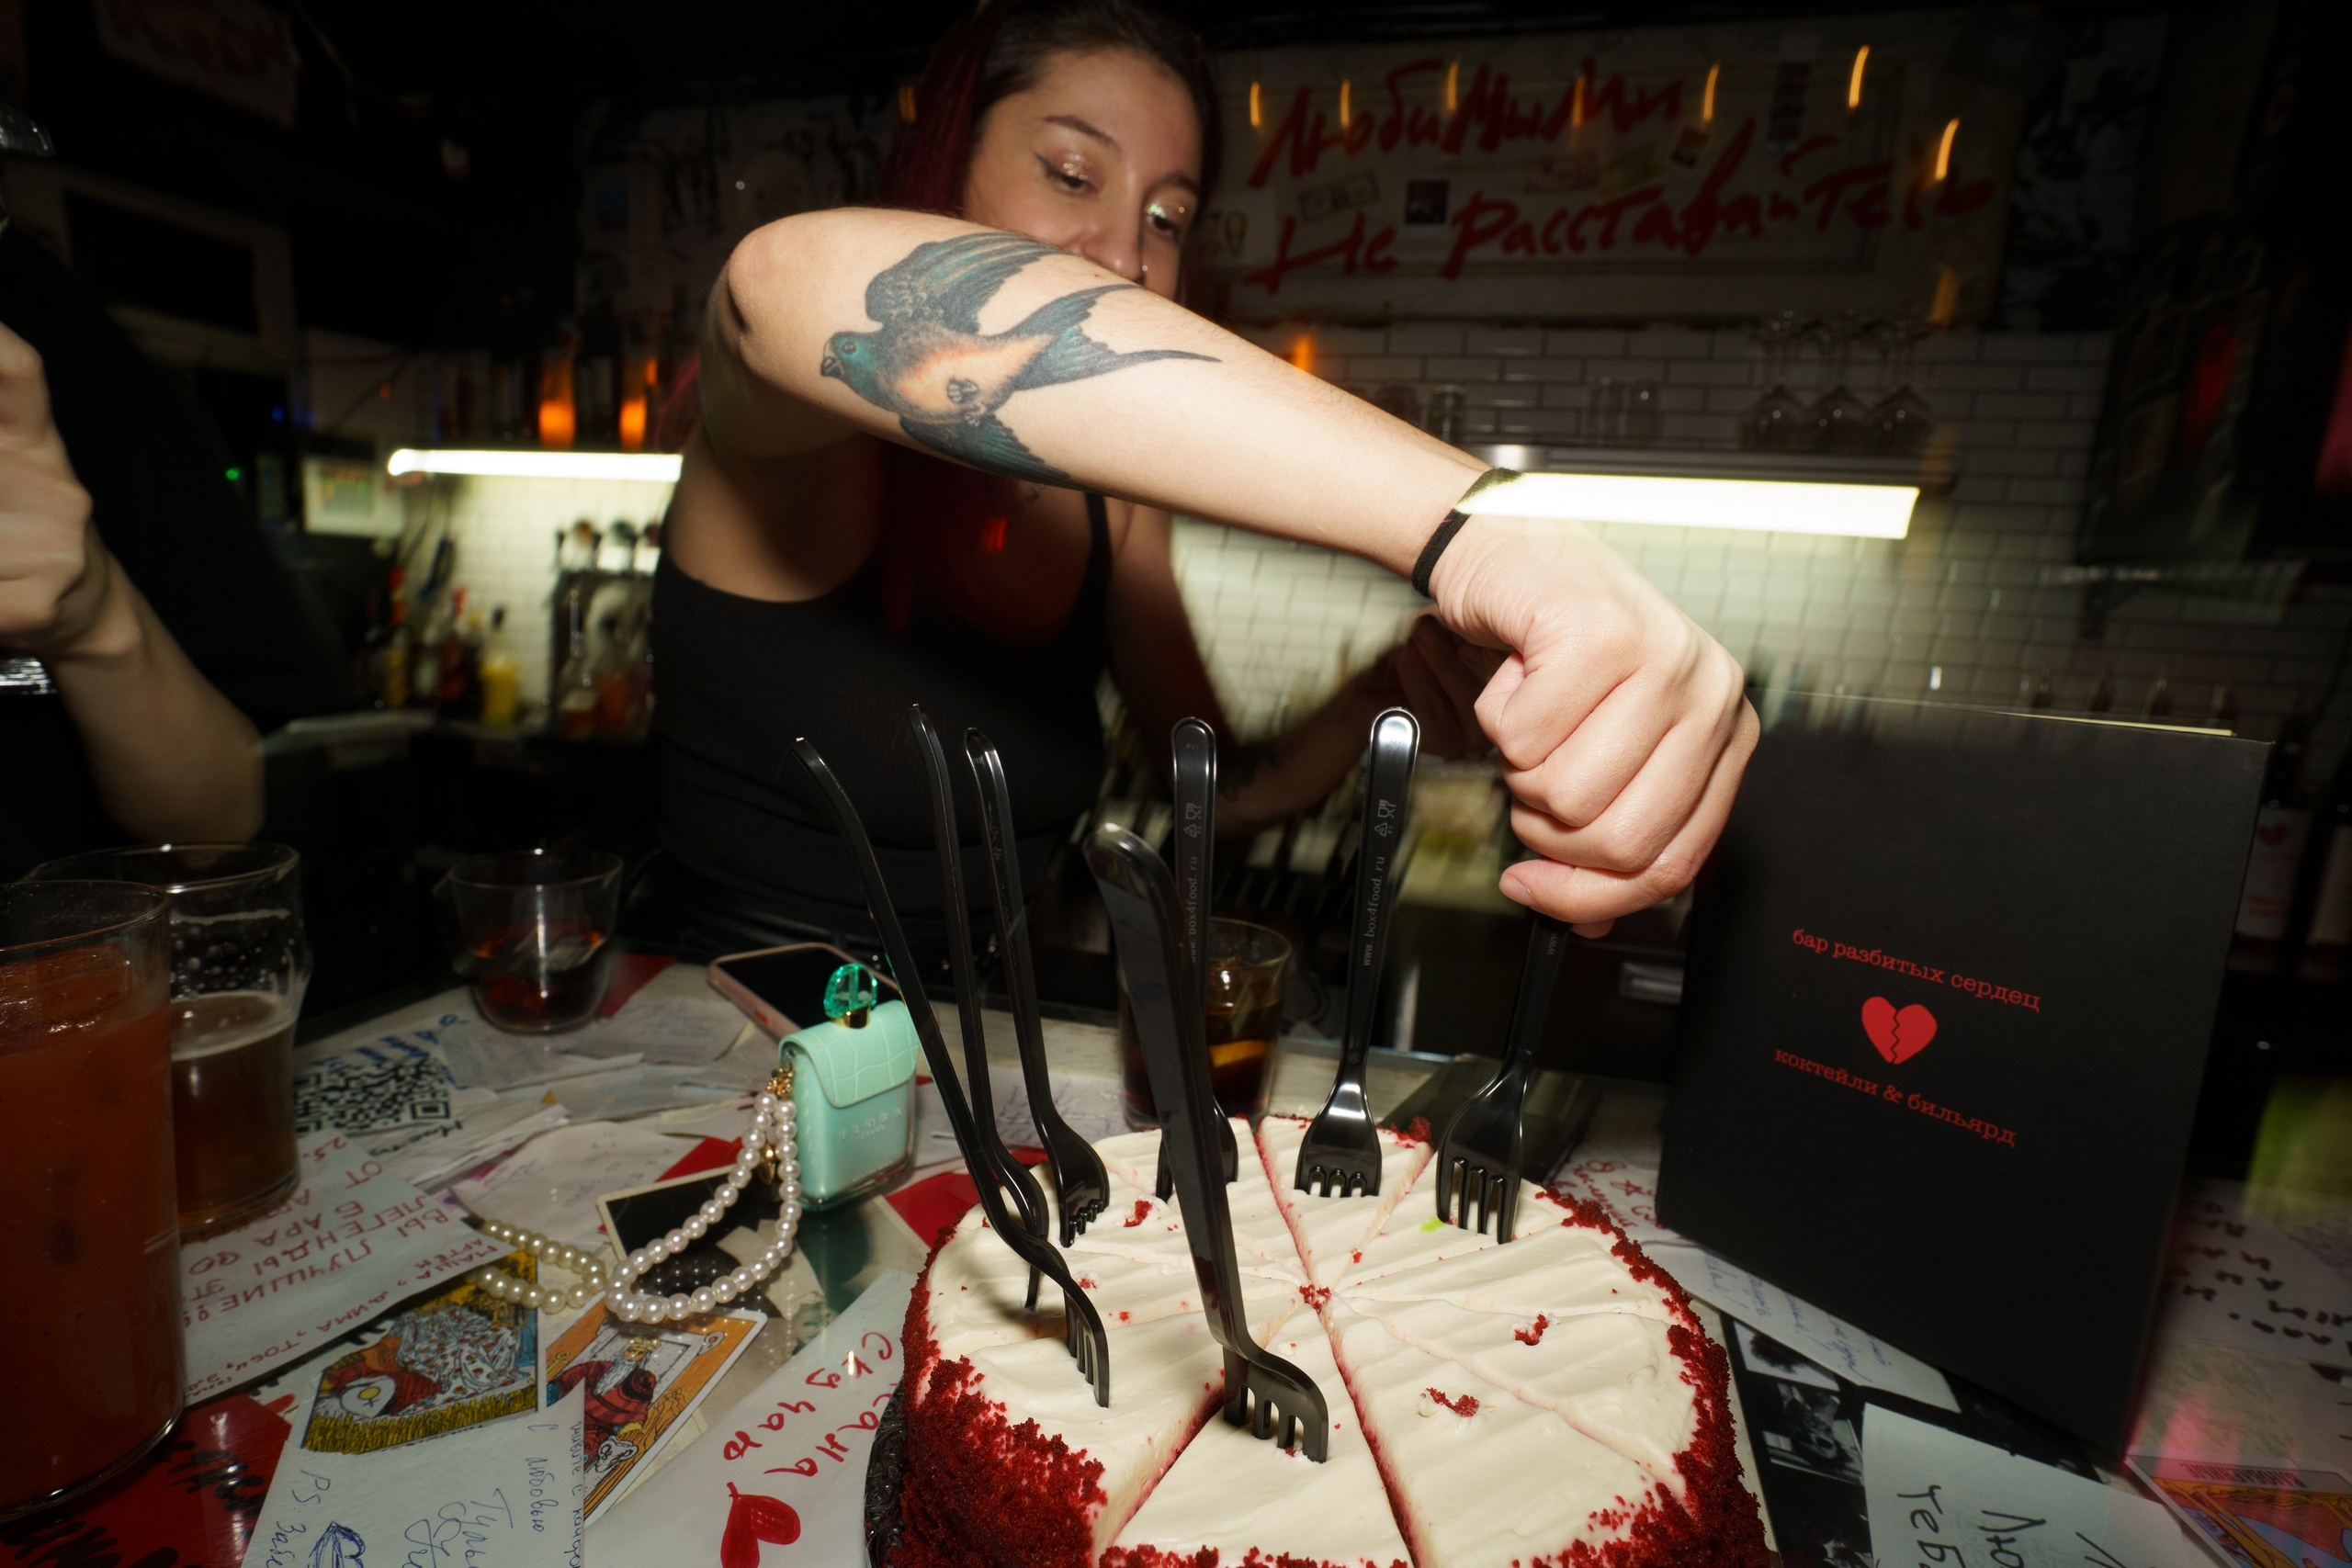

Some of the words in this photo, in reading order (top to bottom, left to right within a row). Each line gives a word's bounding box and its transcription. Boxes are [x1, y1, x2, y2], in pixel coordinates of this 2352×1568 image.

[1245, 212, 1400, 295] Не
[1792, 929, 1828, 953] бар
[1833, 942, 1945, 984] разбитых
[1951, 973, 2041, 1012] сердец
[1774, 1048, 1879, 1097] коктейли
[1883, 1085, 1904, 1103] &
[1907, 1093, 2017, 1148] бильярд
